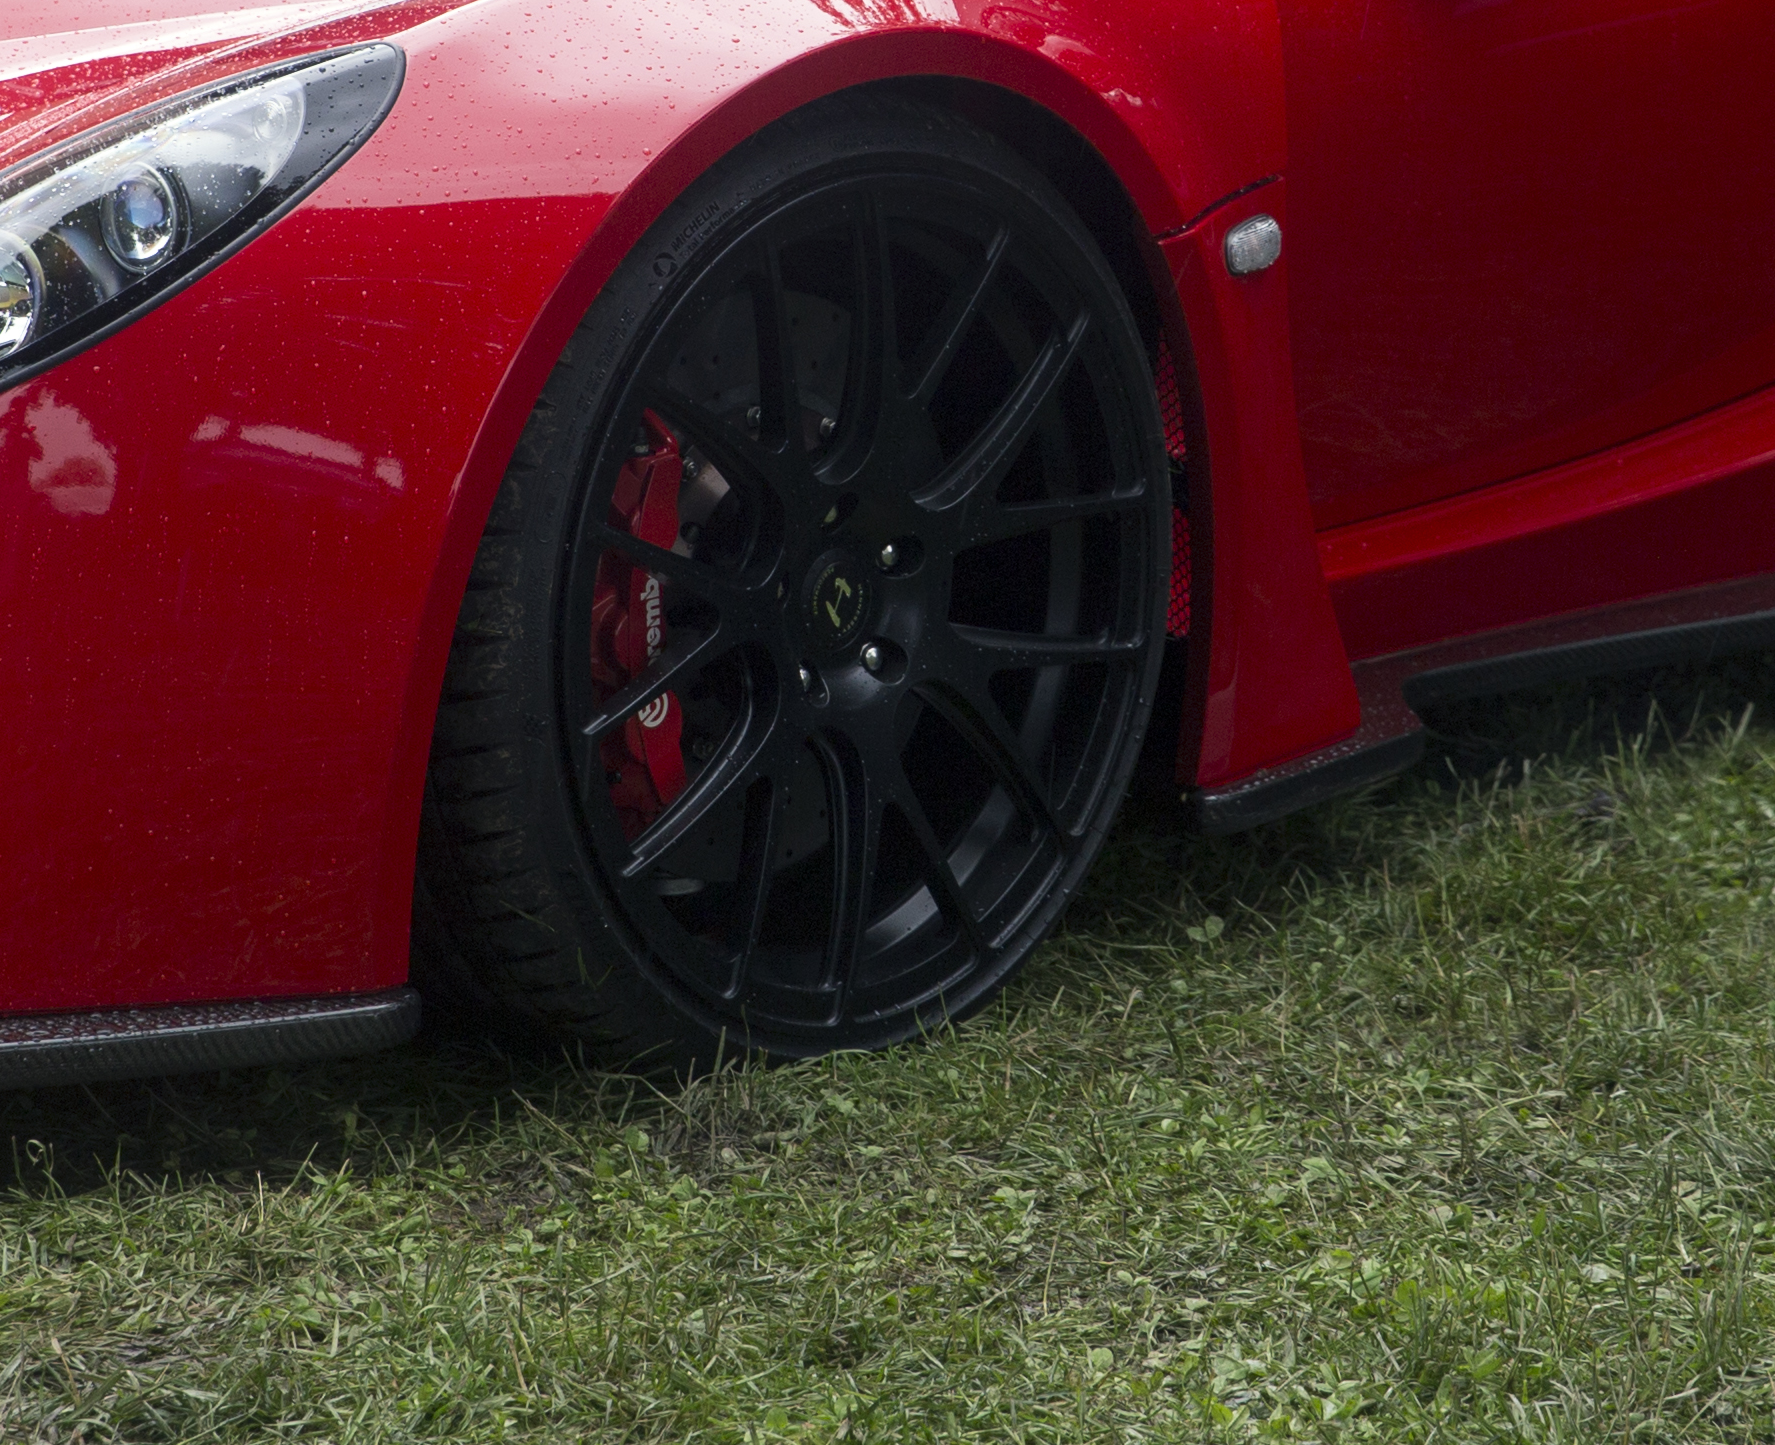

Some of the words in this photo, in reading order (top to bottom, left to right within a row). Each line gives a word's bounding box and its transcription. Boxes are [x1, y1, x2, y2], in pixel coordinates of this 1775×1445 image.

[670, 200, 721, 252] MICHELIN
[679, 236, 702, 260] Total
[639, 577, 662, 667] remb
